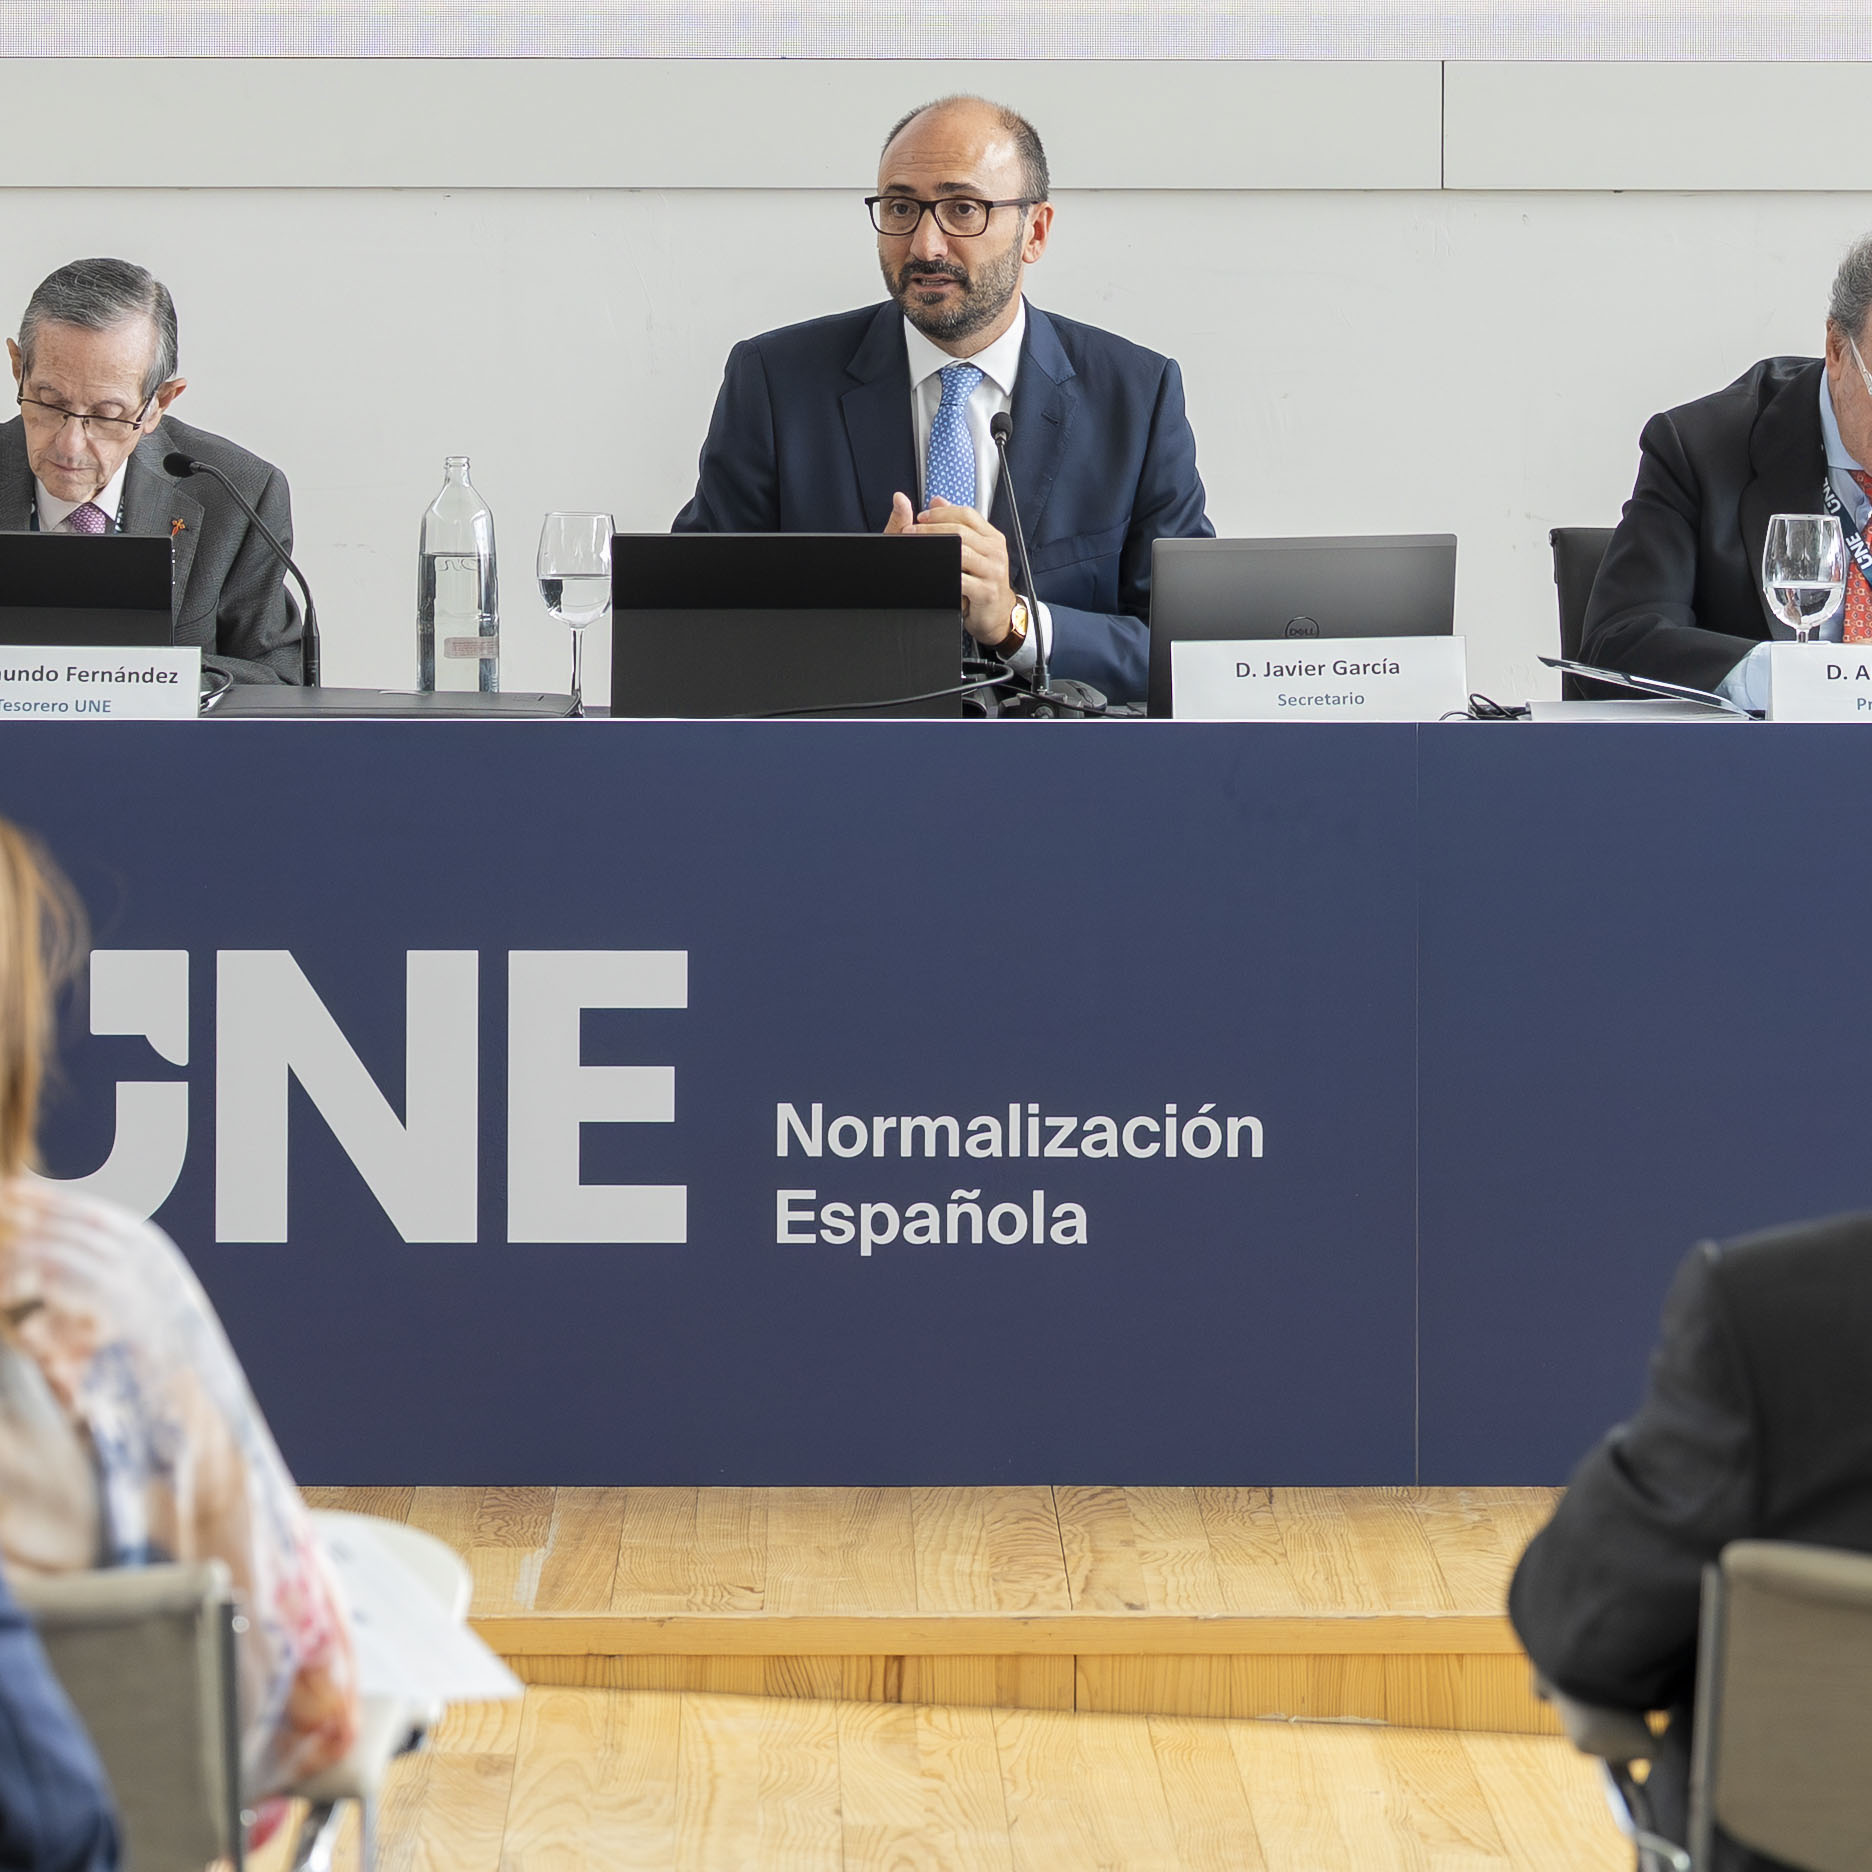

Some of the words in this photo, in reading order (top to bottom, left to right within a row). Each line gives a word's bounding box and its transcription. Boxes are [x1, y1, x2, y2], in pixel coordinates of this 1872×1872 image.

[67, 667, 177, 683] Fernández
[1237, 663, 1256, 677] D.
[1264, 661, 1325, 677] Javier
[1333, 658, 1399, 675] García
[1828, 665, 1847, 679] D.
[76, 700, 111, 712] UNE
[1279, 692, 1364, 706] Secretario
[777, 1103, 1263, 1158] Normalización
[777, 1189, 1087, 1256] Española
